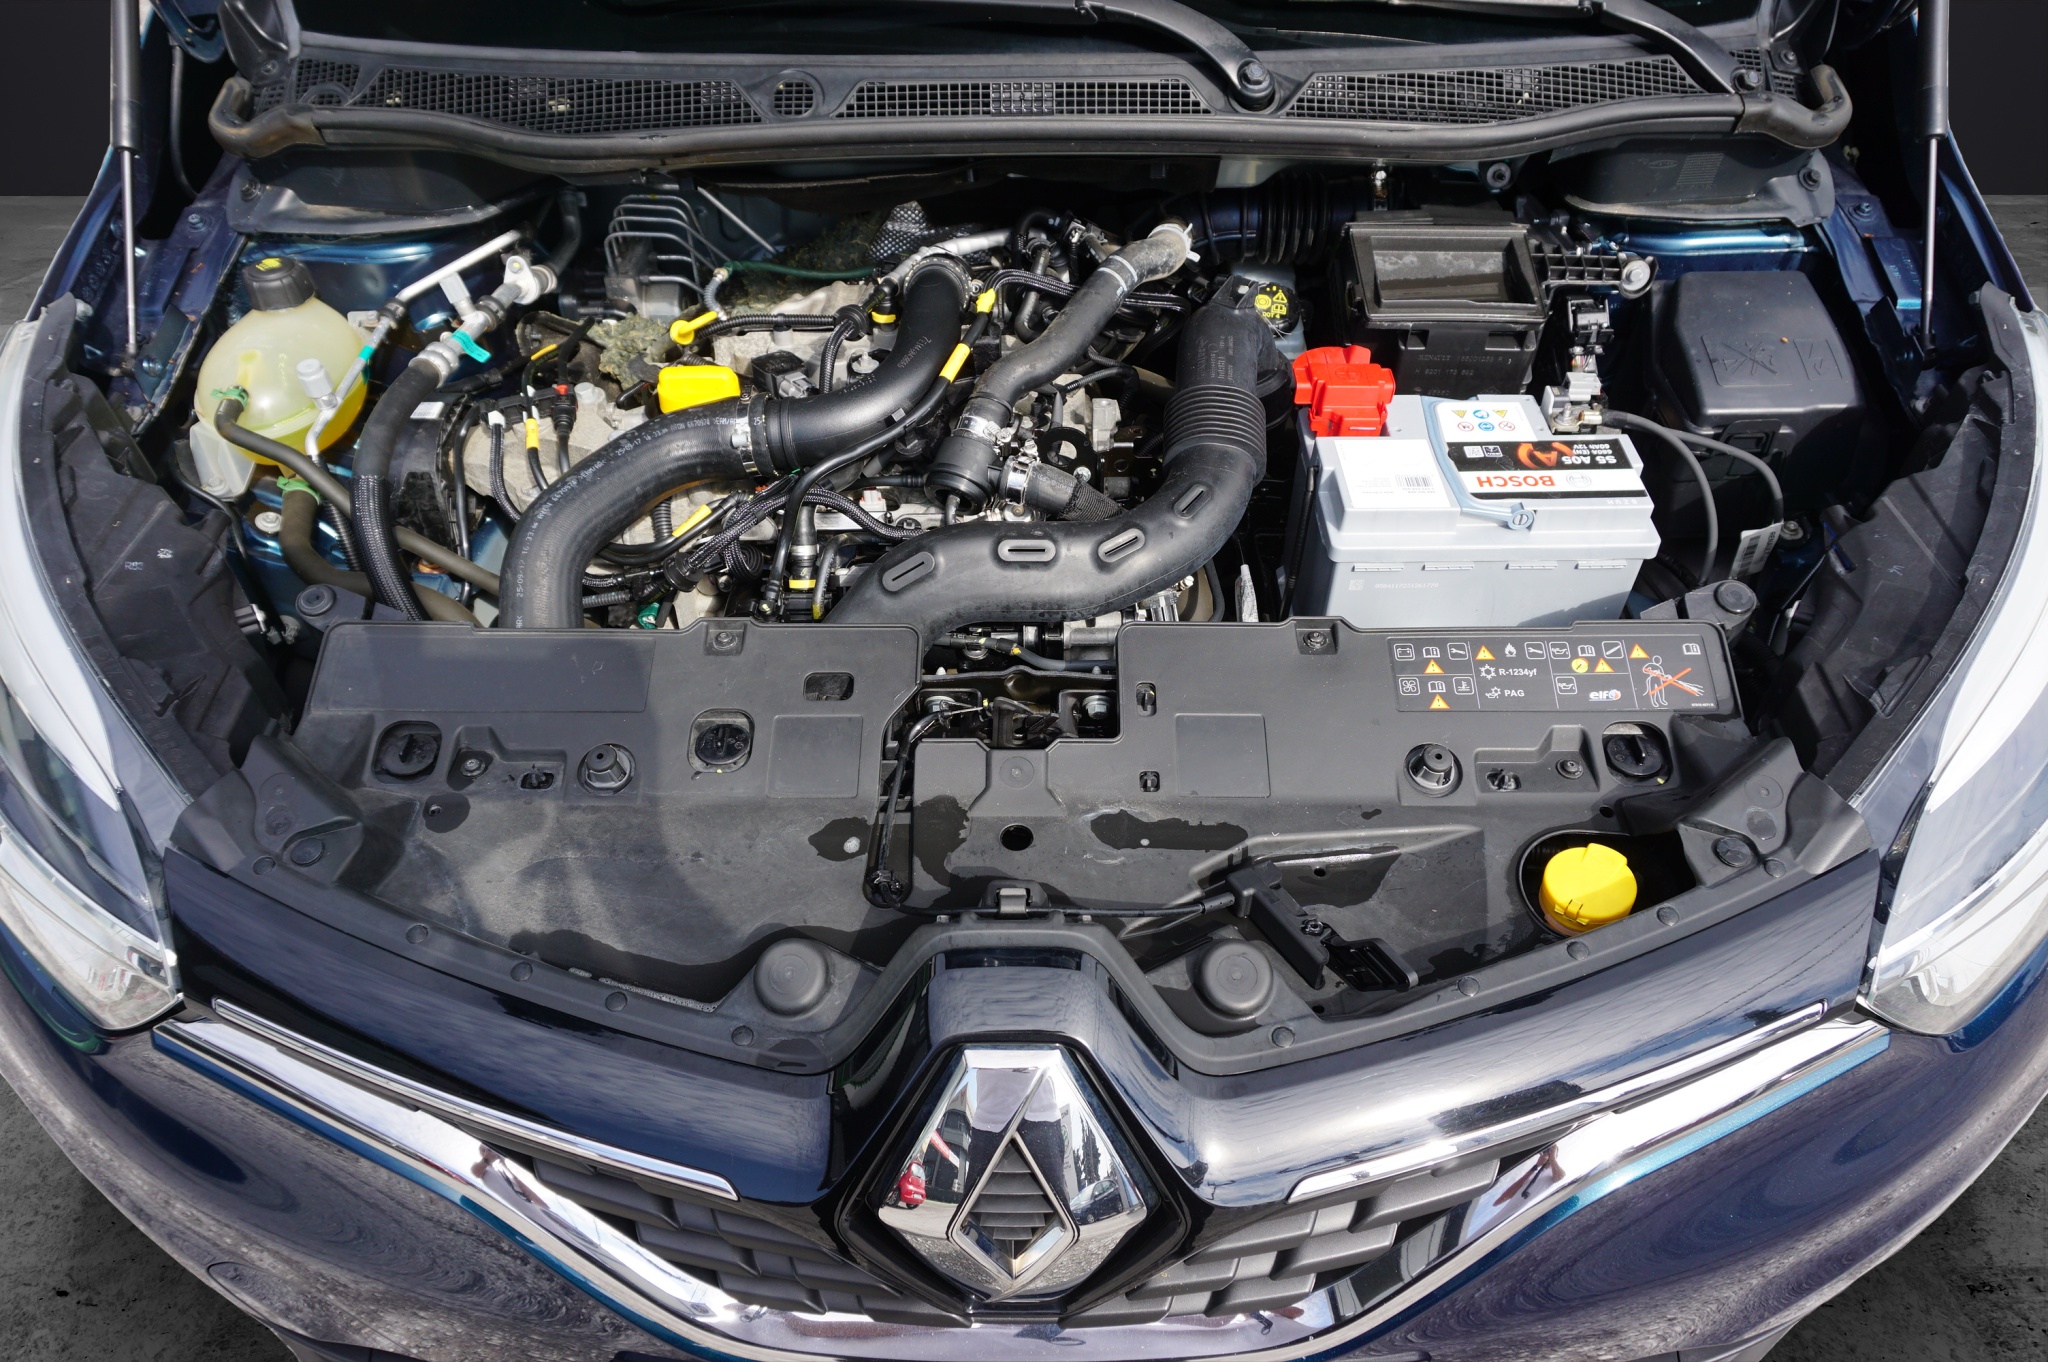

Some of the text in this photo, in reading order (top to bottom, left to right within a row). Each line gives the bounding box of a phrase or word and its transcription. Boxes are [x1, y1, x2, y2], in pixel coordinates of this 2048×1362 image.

[1561, 455, 1618, 465] S5 A05
[1476, 475, 1556, 488] BOSCH
[1499, 668, 1537, 677] R-1234yf
[1504, 689, 1525, 697] PAG
[1589, 690, 1610, 700] elf
